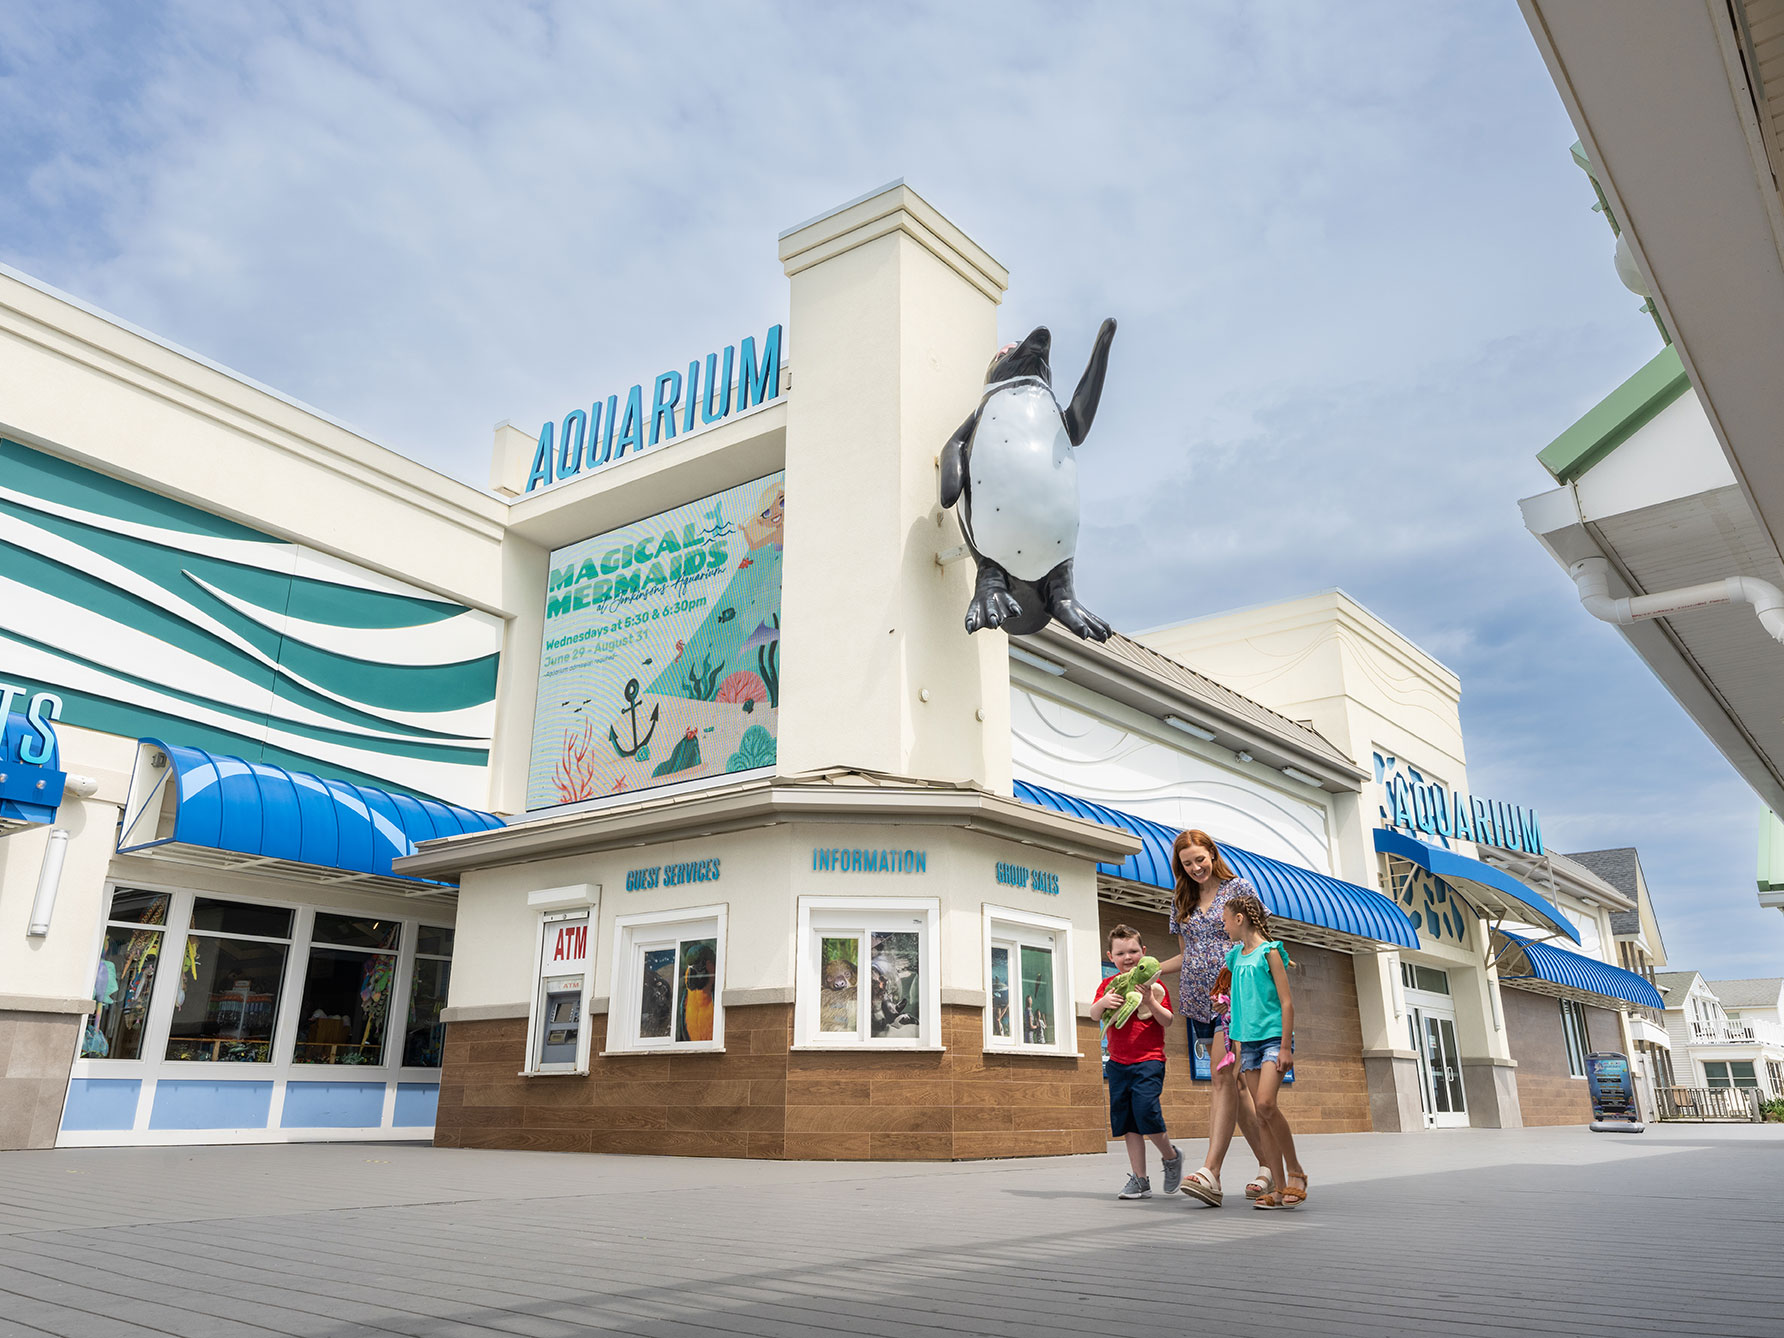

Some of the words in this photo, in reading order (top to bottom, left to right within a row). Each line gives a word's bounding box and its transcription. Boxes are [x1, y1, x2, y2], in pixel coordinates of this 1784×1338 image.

[526, 323, 783, 493] AQUARIUM
[546, 540, 729, 619] MERMAIDS
[549, 522, 704, 593] MAGICAL
[546, 625, 609, 651] Wednesdays
[610, 619, 622, 633] at
[624, 611, 650, 629] 5:30
[651, 608, 661, 620] &
[662, 596, 707, 618] 6:30pm
[543, 653, 571, 668] June
[572, 646, 586, 660] 29
[593, 635, 634, 655] August
[1394, 775, 1545, 856] AQUARIUM
[626, 866, 661, 892] GUEST
[663, 857, 720, 887] SERVICES
[812, 847, 927, 873] INFORMATION
[996, 861, 1030, 888] GROUP
[1031, 869, 1060, 896] SALES
[553, 925, 588, 961] ATM
